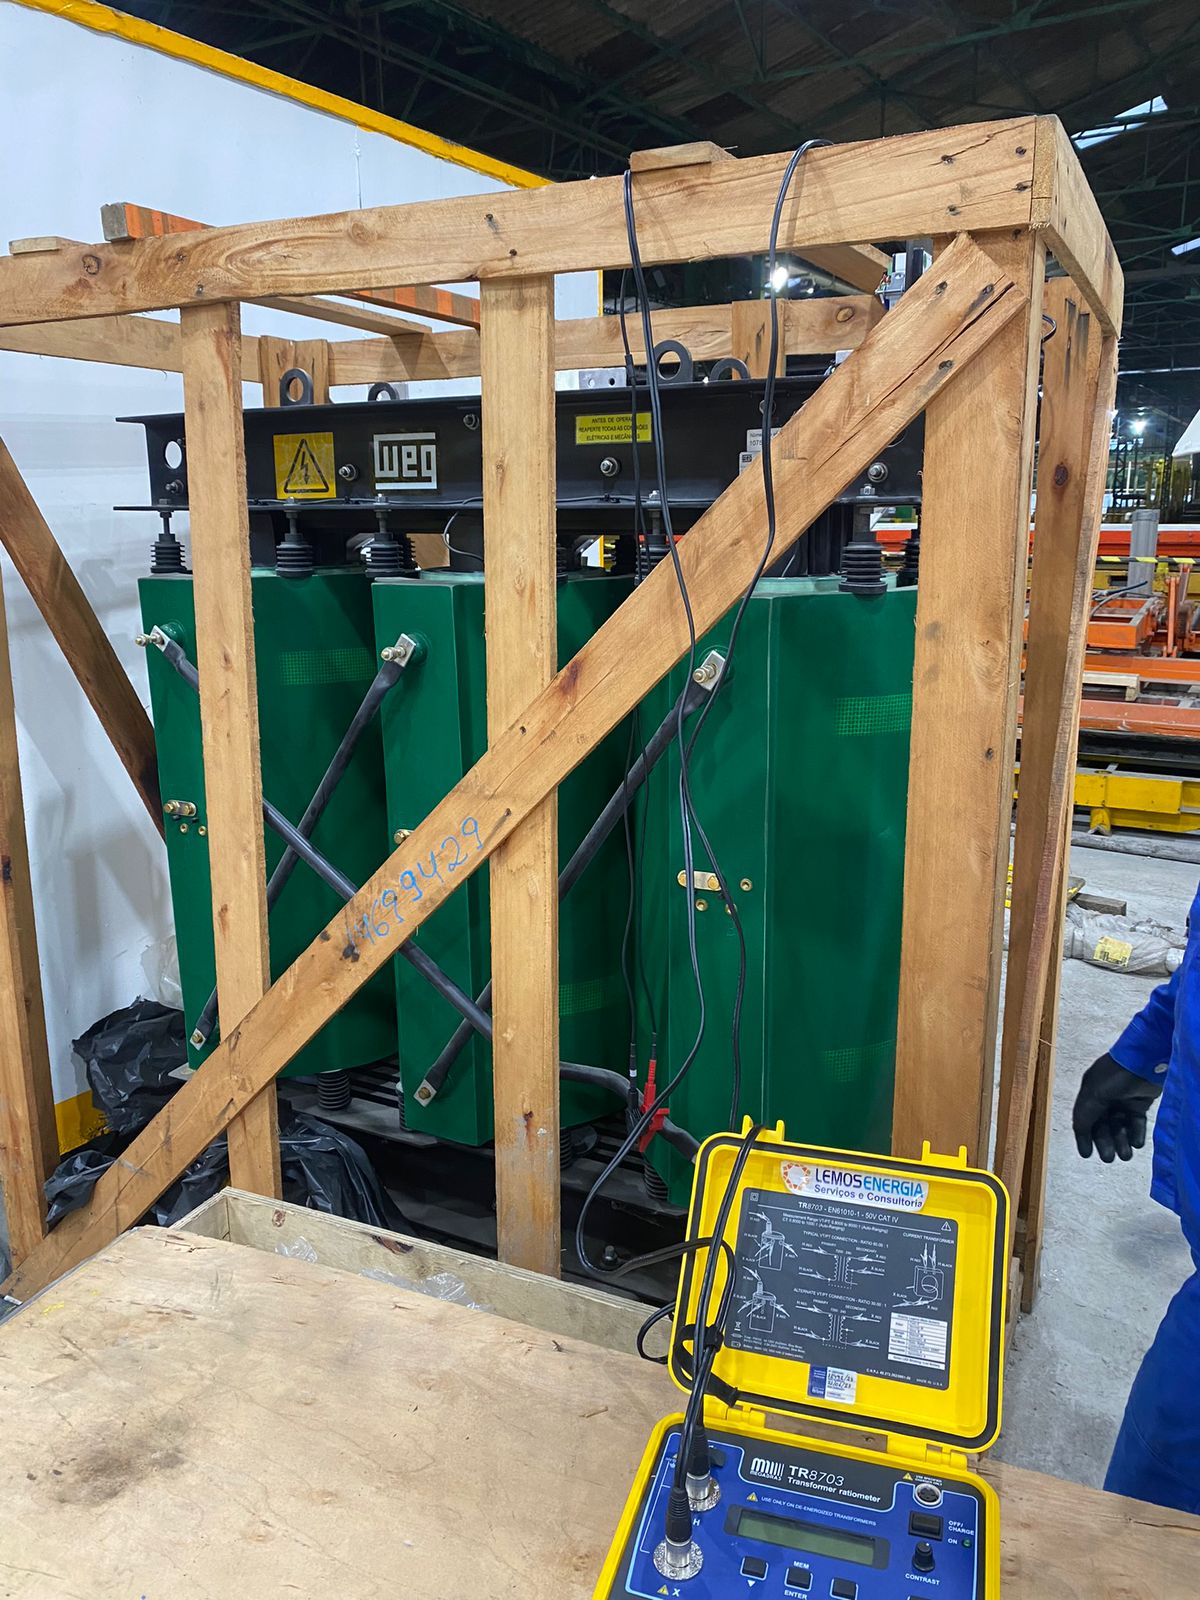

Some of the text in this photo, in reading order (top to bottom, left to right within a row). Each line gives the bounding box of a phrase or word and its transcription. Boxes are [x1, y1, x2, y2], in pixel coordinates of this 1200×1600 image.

[814, 1184, 923, 1208] Serviços e Consultoria
[798, 1202, 823, 1212] TR8703
[828, 1206, 860, 1218] EN61010-1
[878, 1214, 891, 1222] CAT
[831, 1235, 858, 1244] CONNECTION
[903, 1232, 955, 1244] CURRENT TRANSFORMER
[794, 1288, 816, 1296] ALTERNATE
[828, 1293, 856, 1302] CONNECTION
[750, 1470, 782, 1481] MEGABRAS
[789, 1466, 844, 1486] TR8703
[788, 1476, 880, 1503] Transformer ratiometer
[772, 1498, 786, 1506] ONLY
[795, 1504, 833, 1517] DE-ENERGIZED
[834, 1512, 876, 1526] TRANSFORMERS
[693, 1518, 700, 1526] H
[948, 1520, 964, 1528] OFF/
[948, 1526, 974, 1536] CHARGE
[794, 1561, 810, 1569] MEM
[905, 1573, 940, 1586] CONTRAST
[672, 1588, 681, 1596] X
[784, 1589, 808, 1599] ENTER
